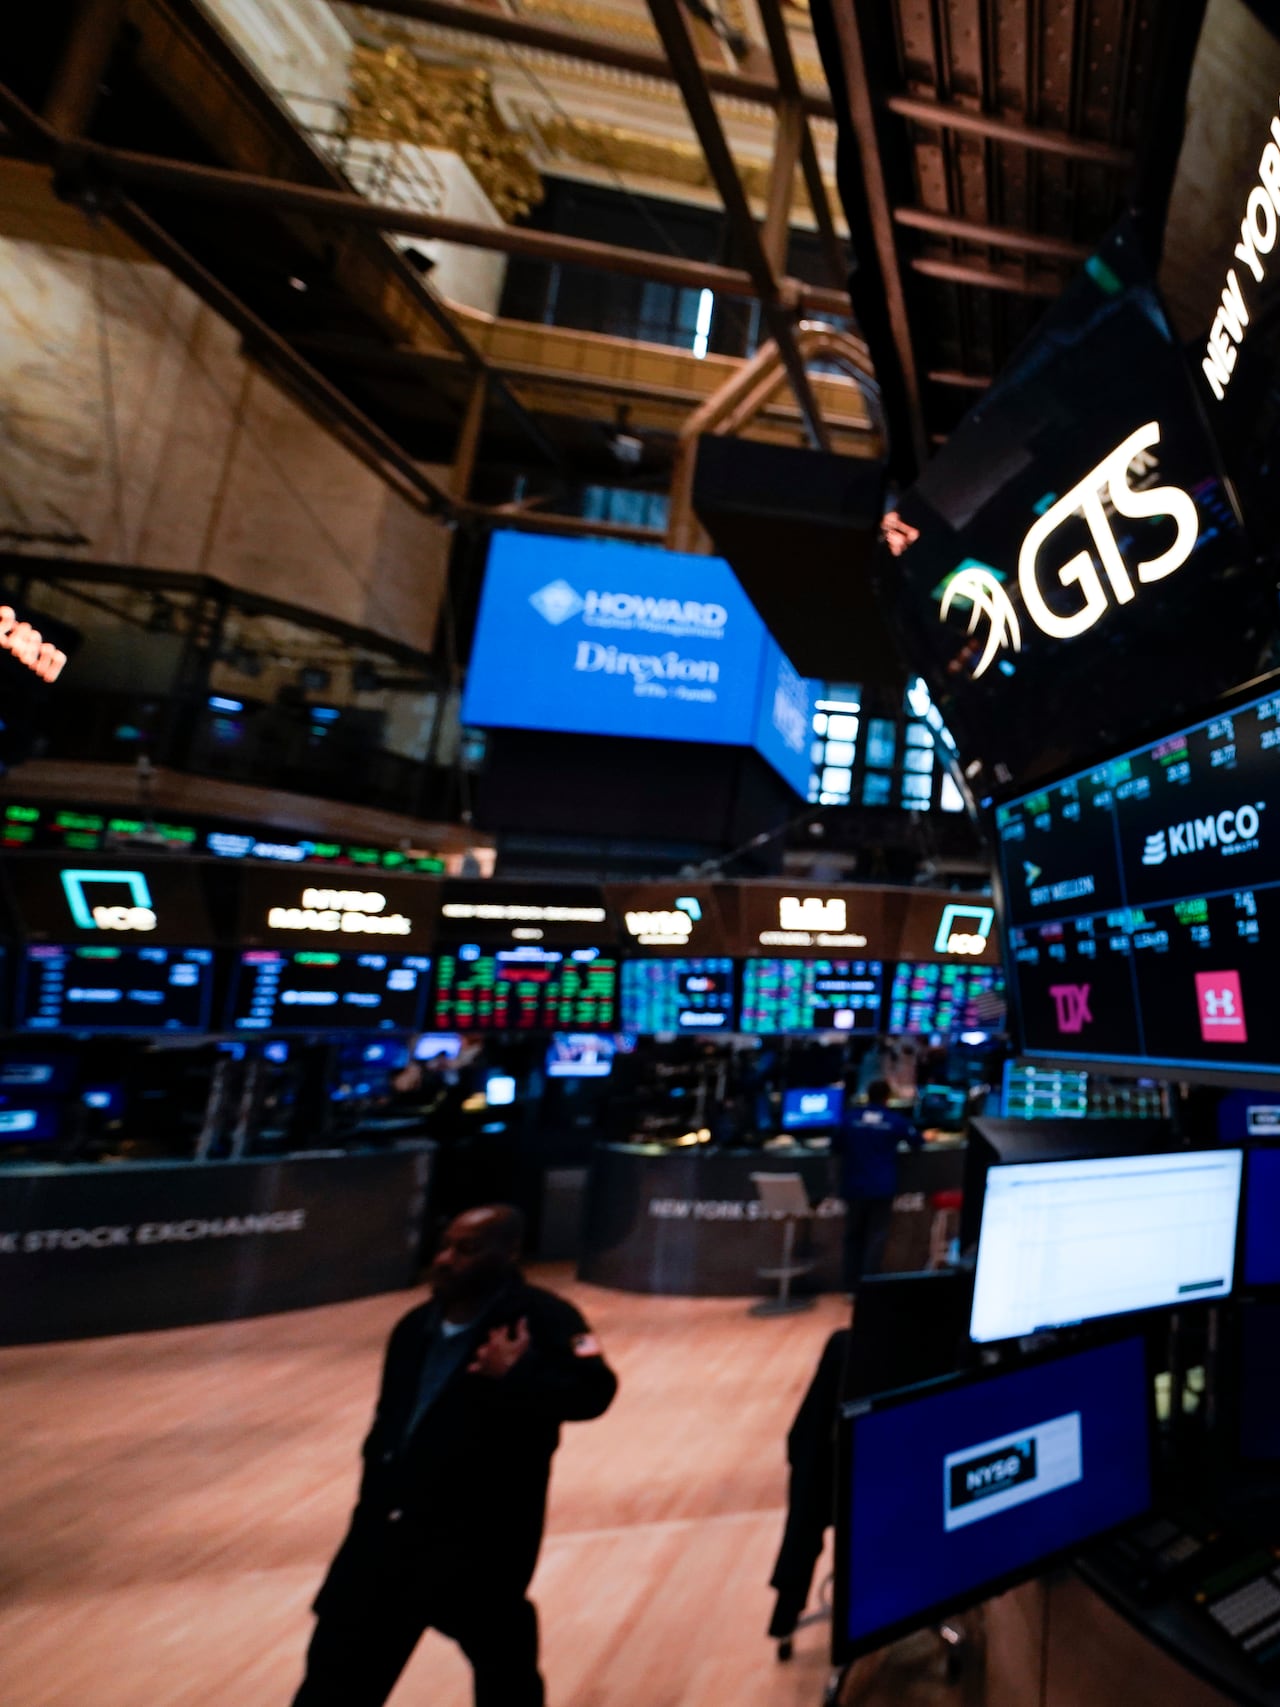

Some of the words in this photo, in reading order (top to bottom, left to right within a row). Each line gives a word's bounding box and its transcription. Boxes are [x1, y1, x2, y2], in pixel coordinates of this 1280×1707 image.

[1202, 268, 1249, 400] NEW
[1018, 421, 1199, 638] GTS
[584, 590, 728, 628] HOWARD
[1169, 804, 1260, 856] KIMCO
[24, 1226, 131, 1253] STOCK
[135, 1209, 306, 1245] EXCHANGE
